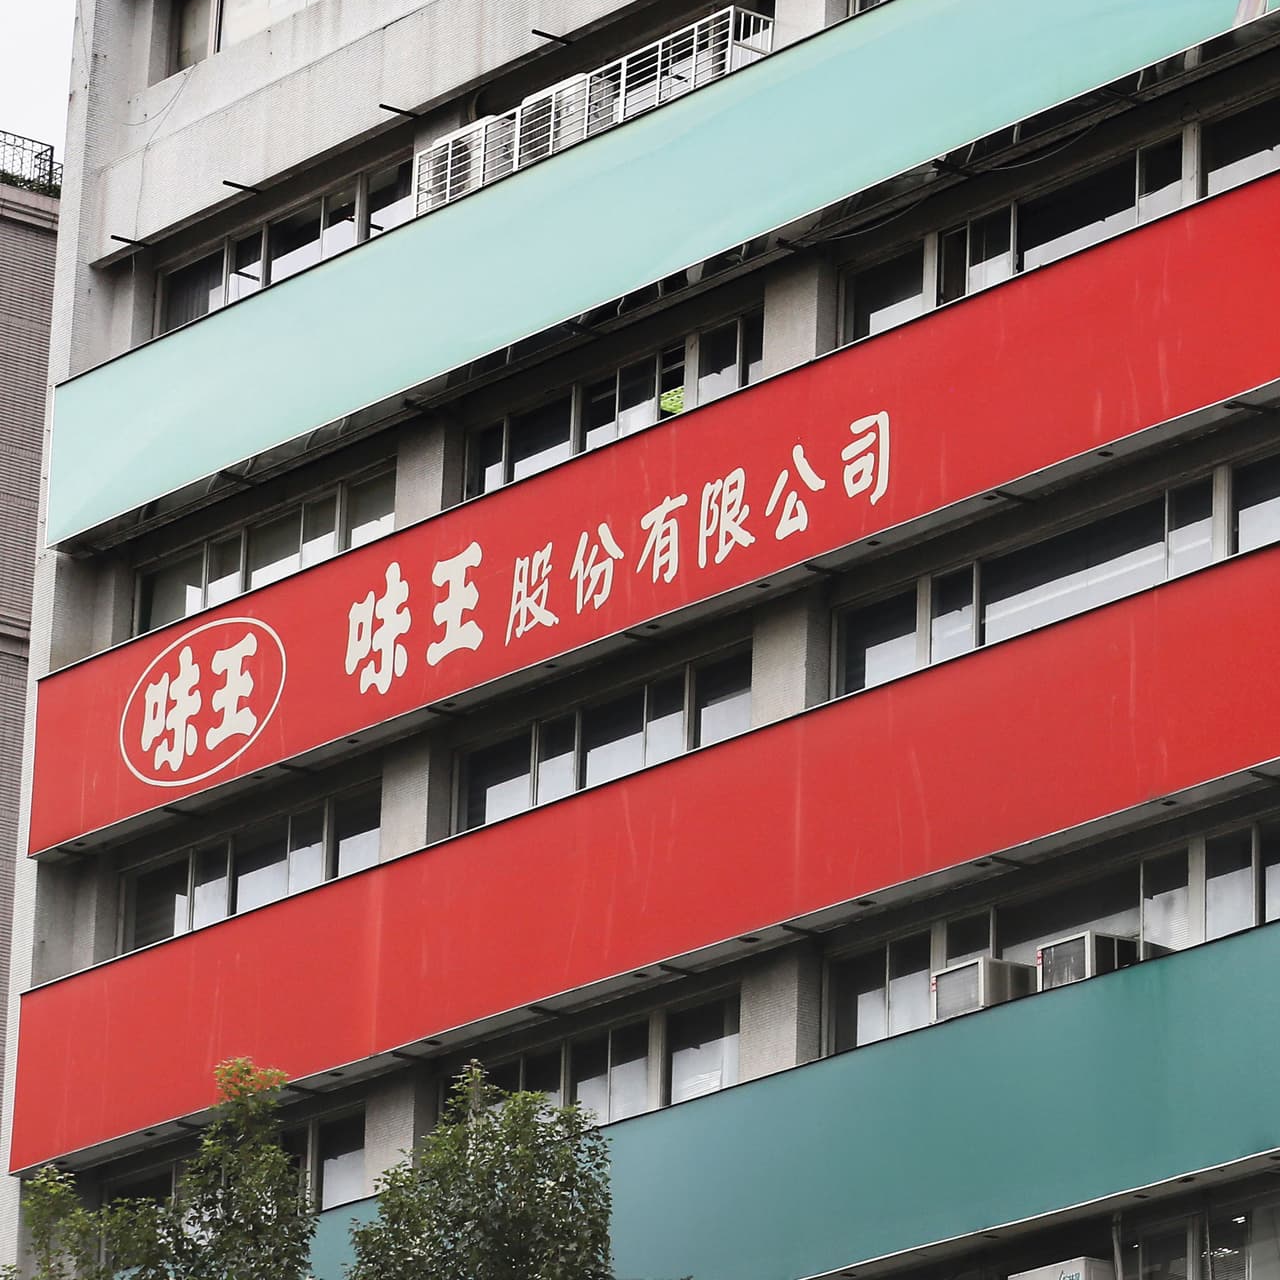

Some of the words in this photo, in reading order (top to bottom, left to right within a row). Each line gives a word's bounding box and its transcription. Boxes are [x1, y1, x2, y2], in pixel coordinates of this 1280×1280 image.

[344, 410, 890, 695] 味王股份有限公司
[140, 632, 258, 772] 味王
